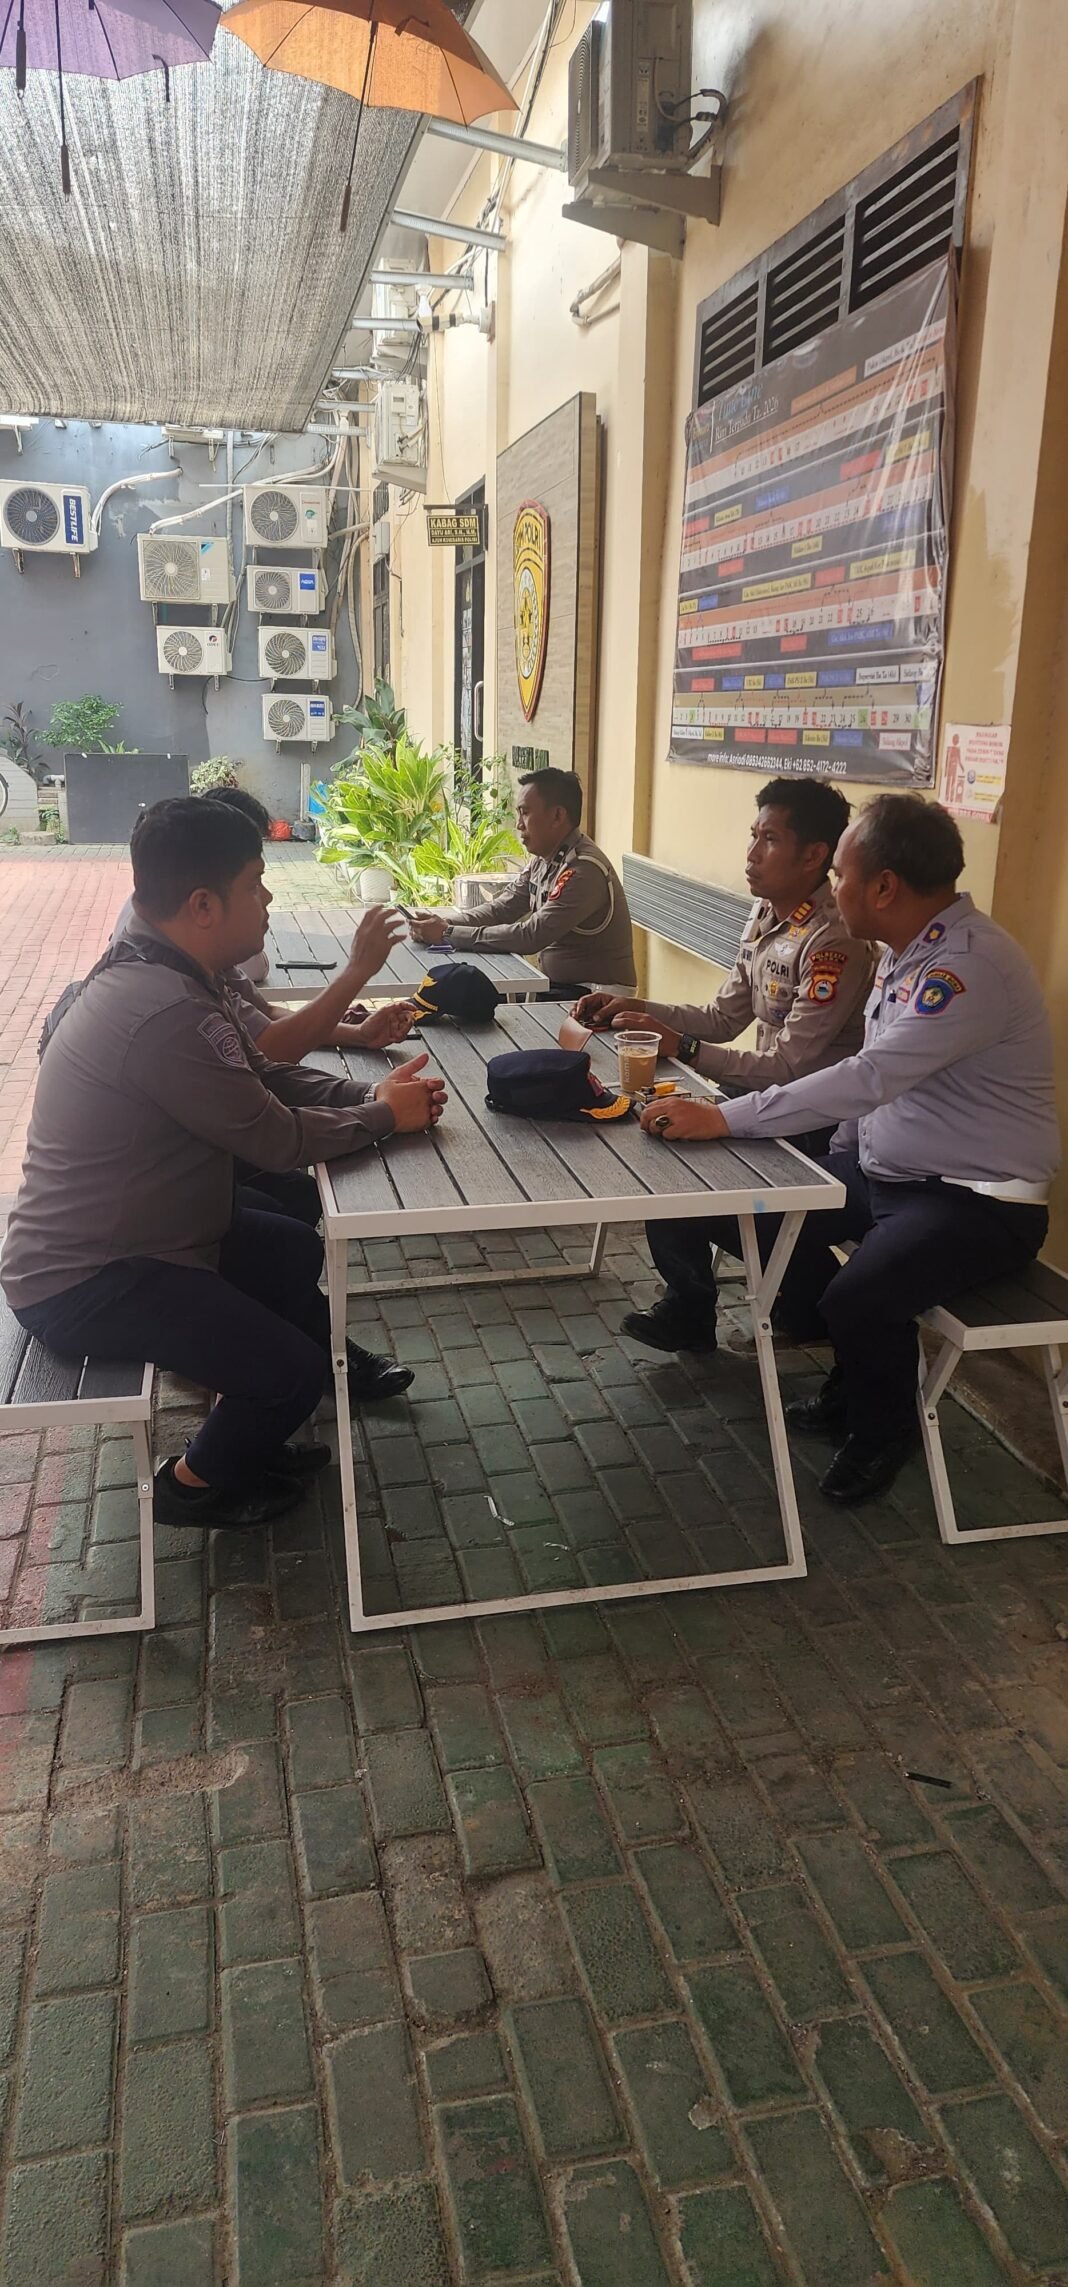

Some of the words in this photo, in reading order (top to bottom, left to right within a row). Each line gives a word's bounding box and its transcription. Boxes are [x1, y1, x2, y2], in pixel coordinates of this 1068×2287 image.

[430, 518, 458, 528] KABAG
[459, 518, 476, 528] SDM
[766, 959, 790, 978] POLRI
